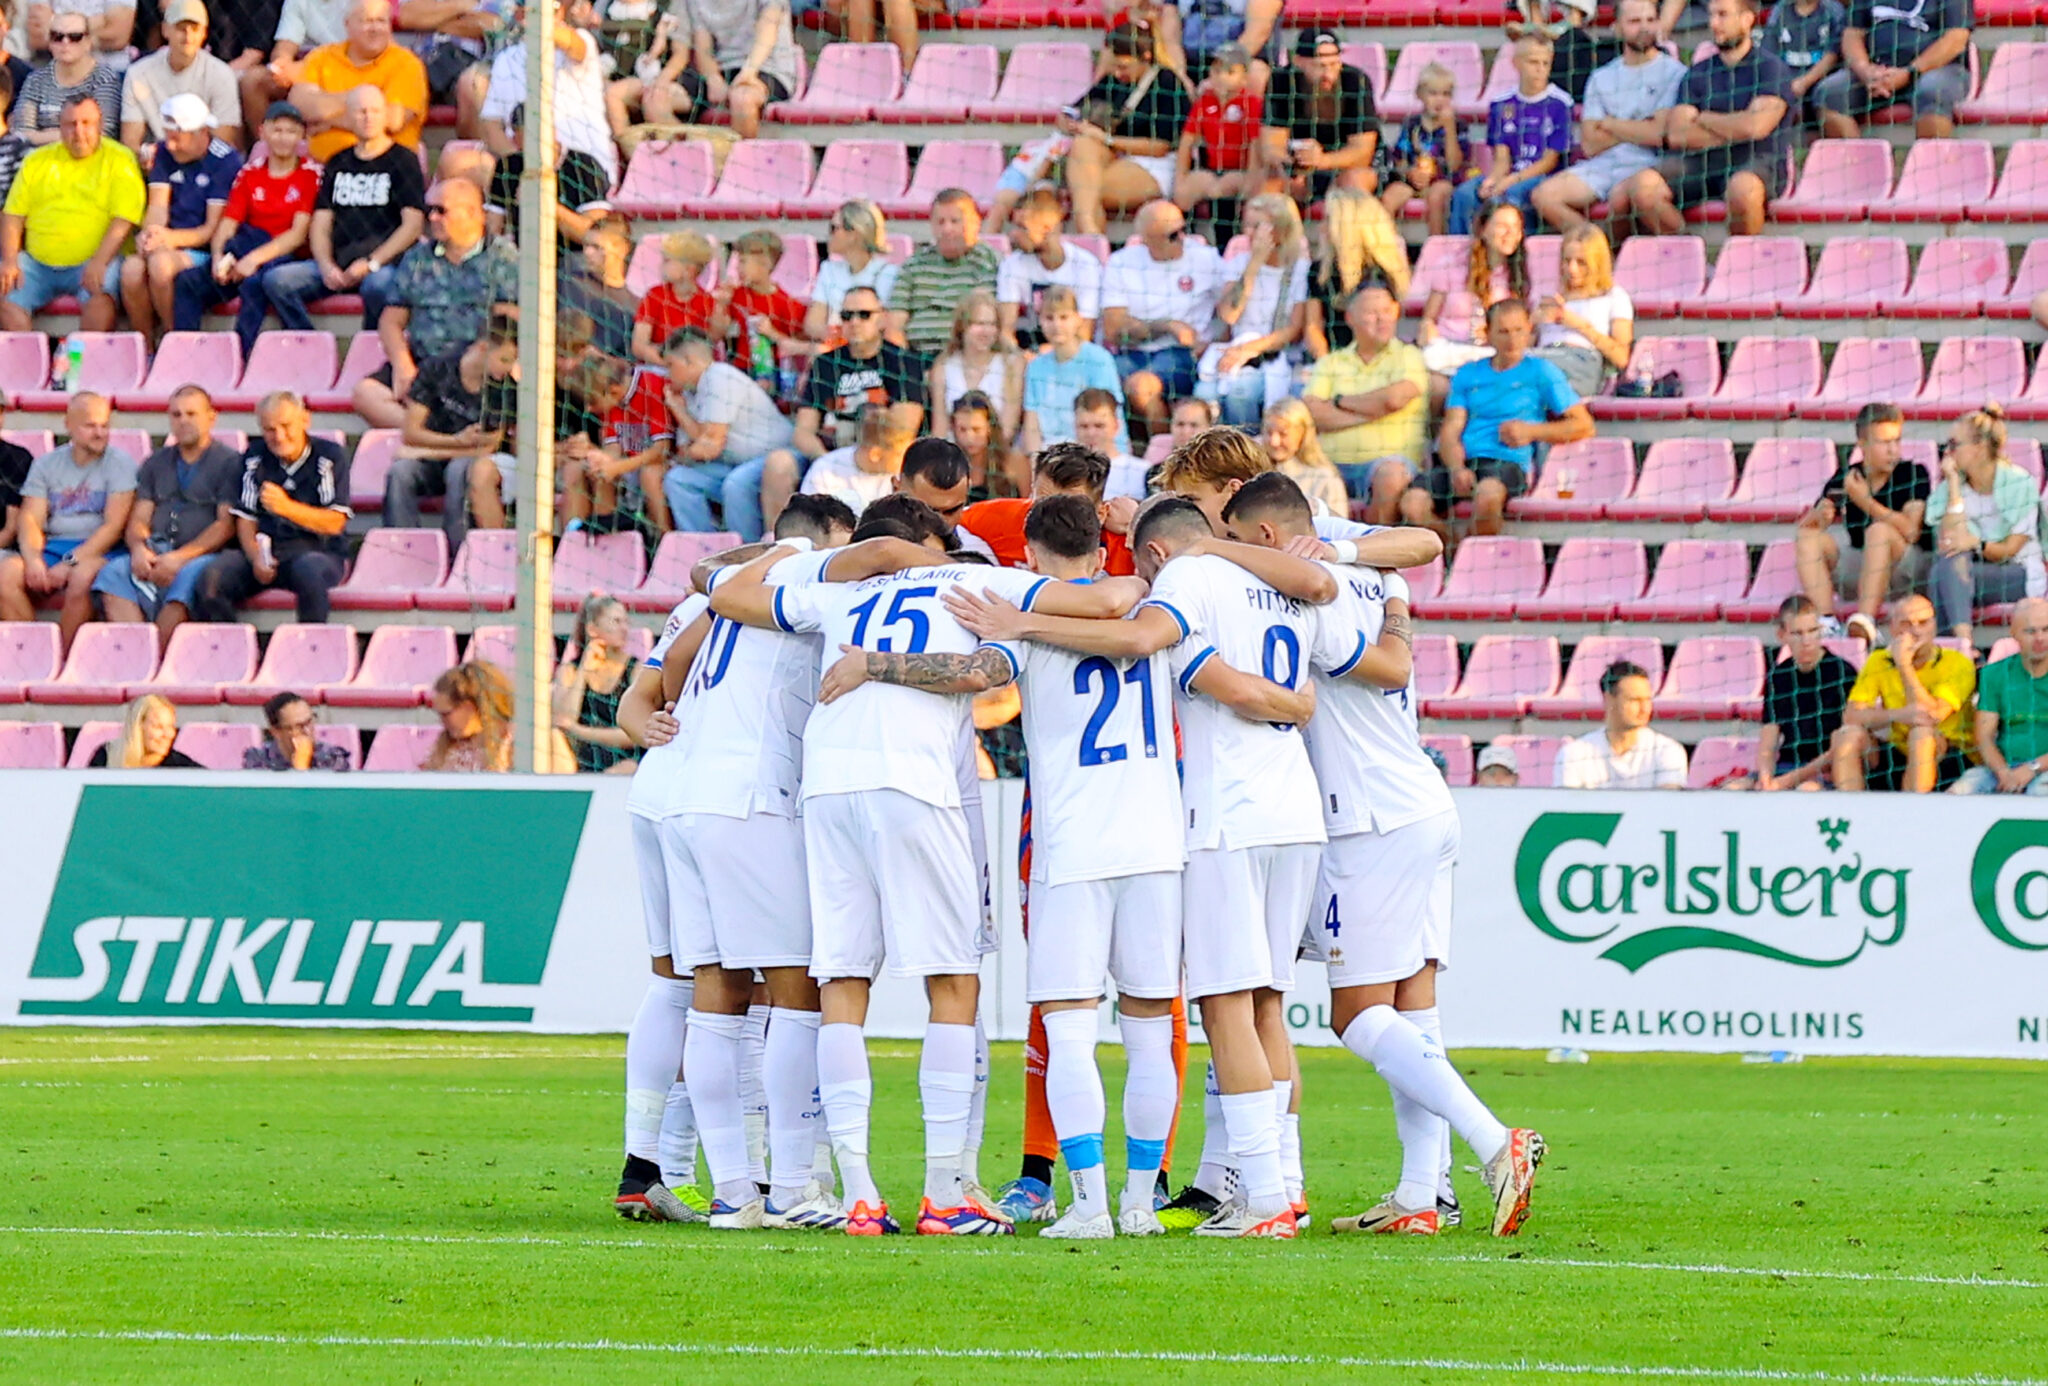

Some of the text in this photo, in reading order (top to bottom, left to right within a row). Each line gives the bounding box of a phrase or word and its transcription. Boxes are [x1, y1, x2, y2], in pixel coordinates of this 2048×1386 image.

[847, 586, 938, 654] 15
[1073, 656, 1158, 767] 21
[1325, 893, 1341, 937] 4
[1515, 812, 1912, 947] Carlsberg
[40, 916, 525, 1007] STIKLITA
[1561, 1009, 1865, 1039] NEALKOHOLINIS
